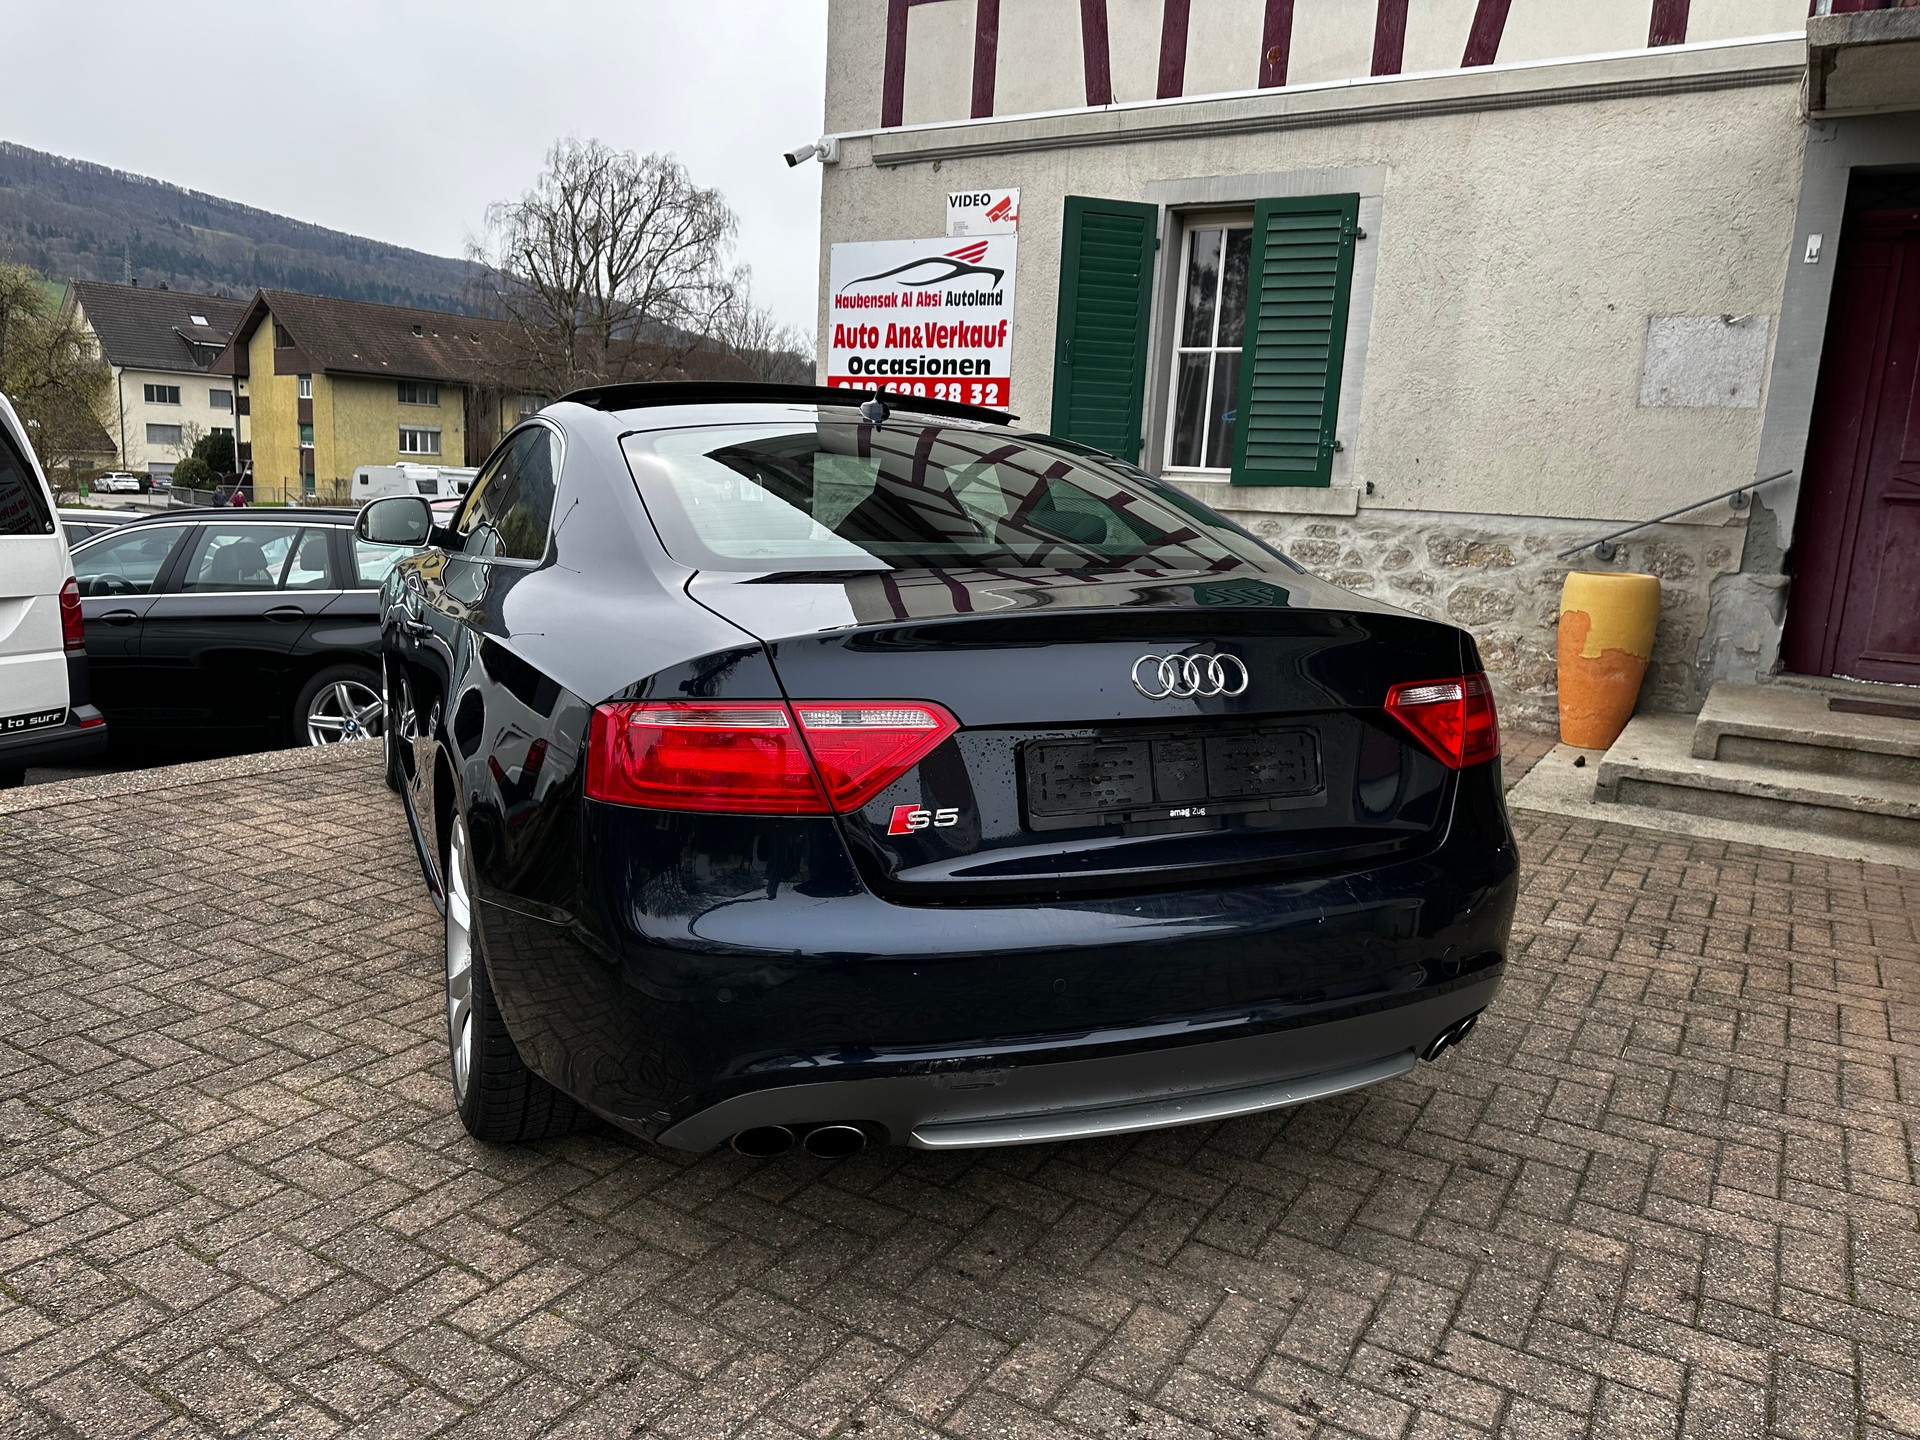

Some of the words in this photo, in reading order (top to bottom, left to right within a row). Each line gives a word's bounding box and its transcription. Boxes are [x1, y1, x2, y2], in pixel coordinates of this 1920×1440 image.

[949, 193, 991, 208] VIDEO
[834, 292, 898, 309] Haubensak
[901, 292, 913, 307] Al
[916, 290, 942, 307] Absi
[945, 289, 1003, 307] Autoland
[833, 323, 880, 349] Auto
[885, 319, 1008, 349] An&Verkauf
[848, 355, 991, 376] Occasionen
[934, 382, 962, 403] 28
[970, 383, 999, 405] 32
[8, 719, 24, 728] to
[30, 713, 61, 725] surf
[906, 808, 959, 829] S5
[1169, 808, 1191, 817] amag
[1192, 807, 1206, 816] Zug
